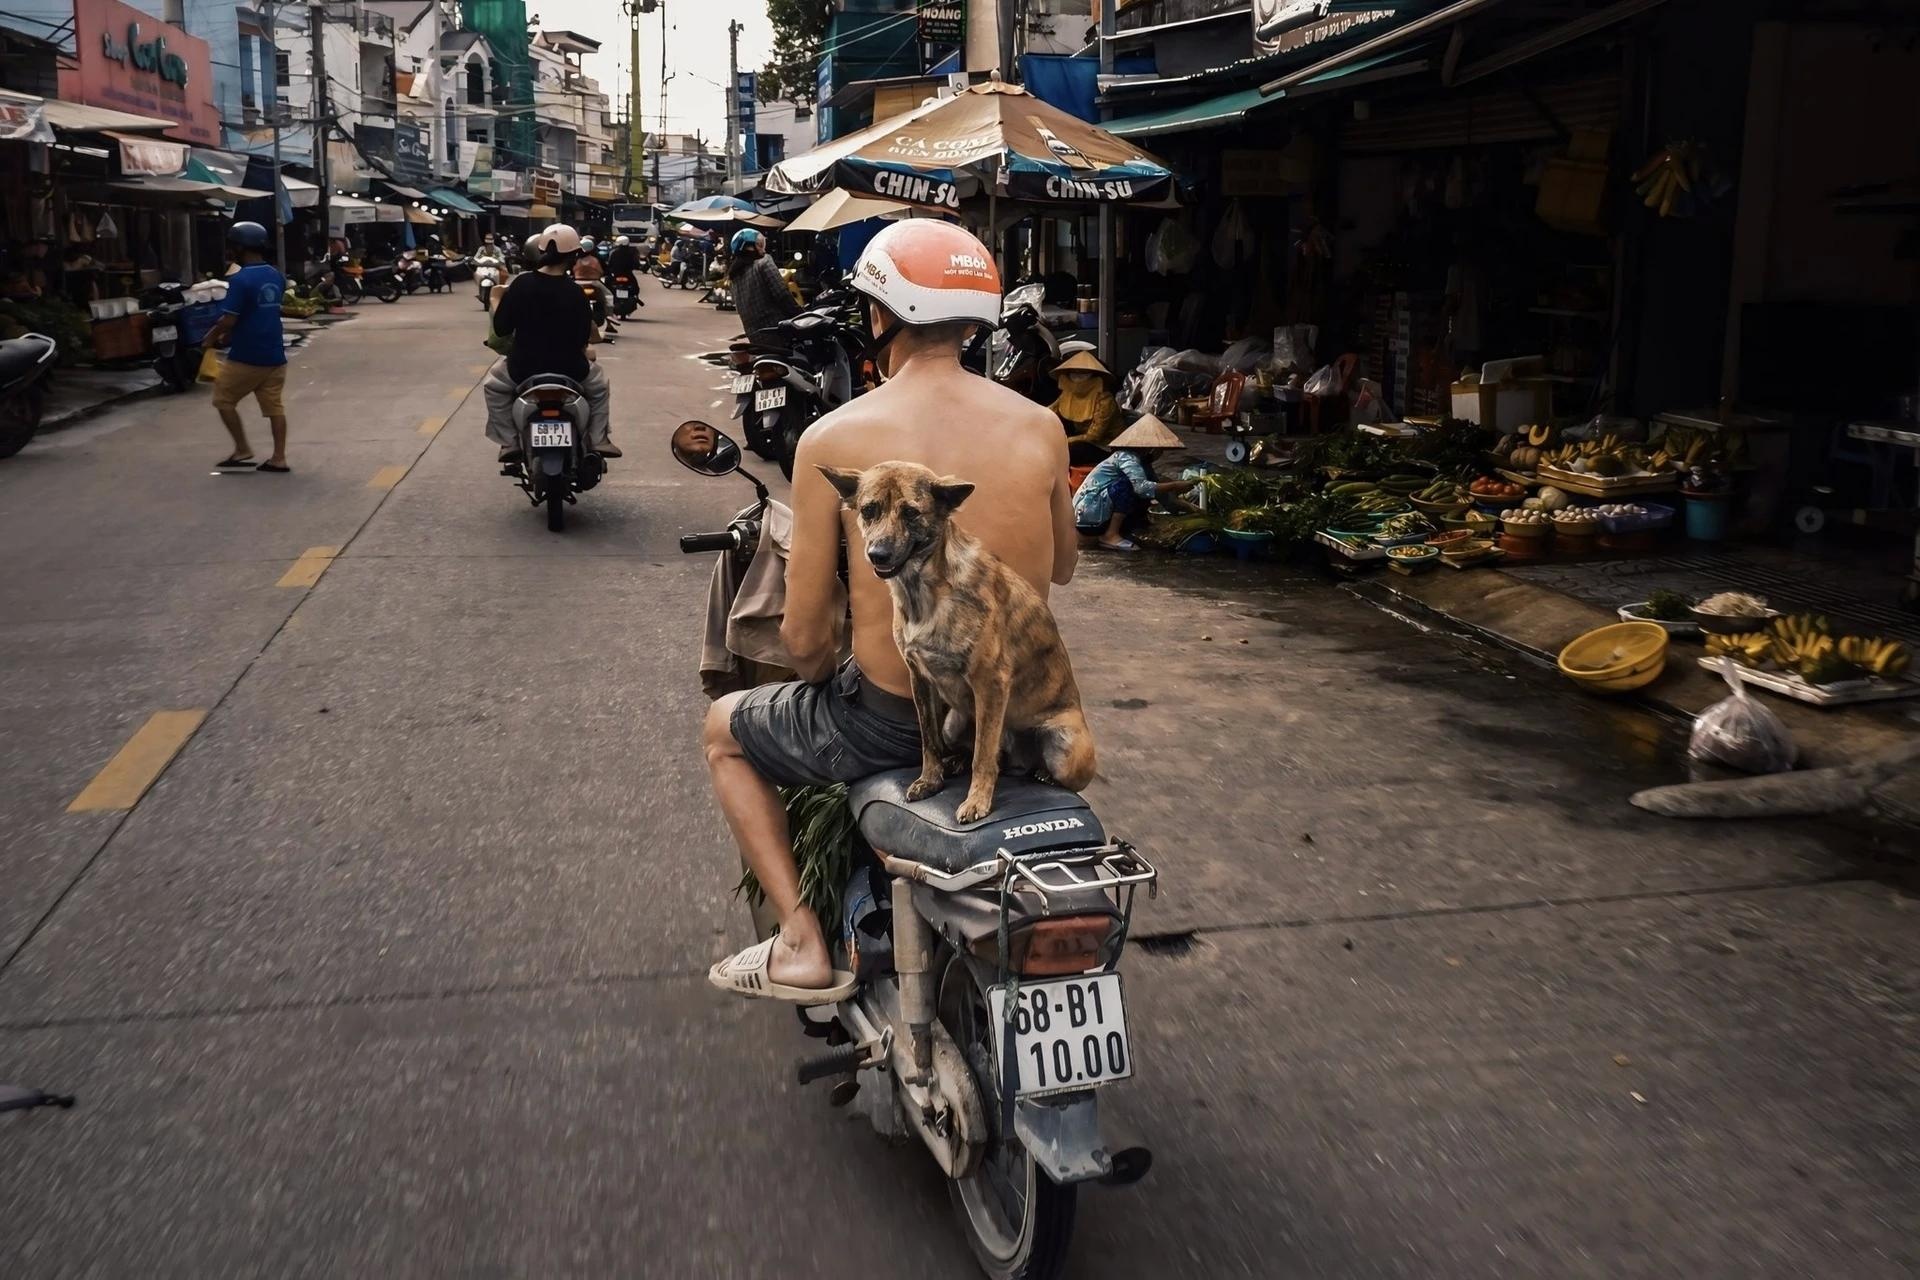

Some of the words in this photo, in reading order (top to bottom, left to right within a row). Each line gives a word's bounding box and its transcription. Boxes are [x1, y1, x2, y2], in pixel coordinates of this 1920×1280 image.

[873, 171, 960, 209] CHIN-SU
[1046, 175, 1133, 200] CHIN-SU
[863, 260, 887, 285] MB66
[950, 254, 988, 271] MB66
[1003, 817, 1085, 840] HONDA
[1015, 981, 1103, 1036] 68-B1
[1030, 1030, 1126, 1087] 10.00
